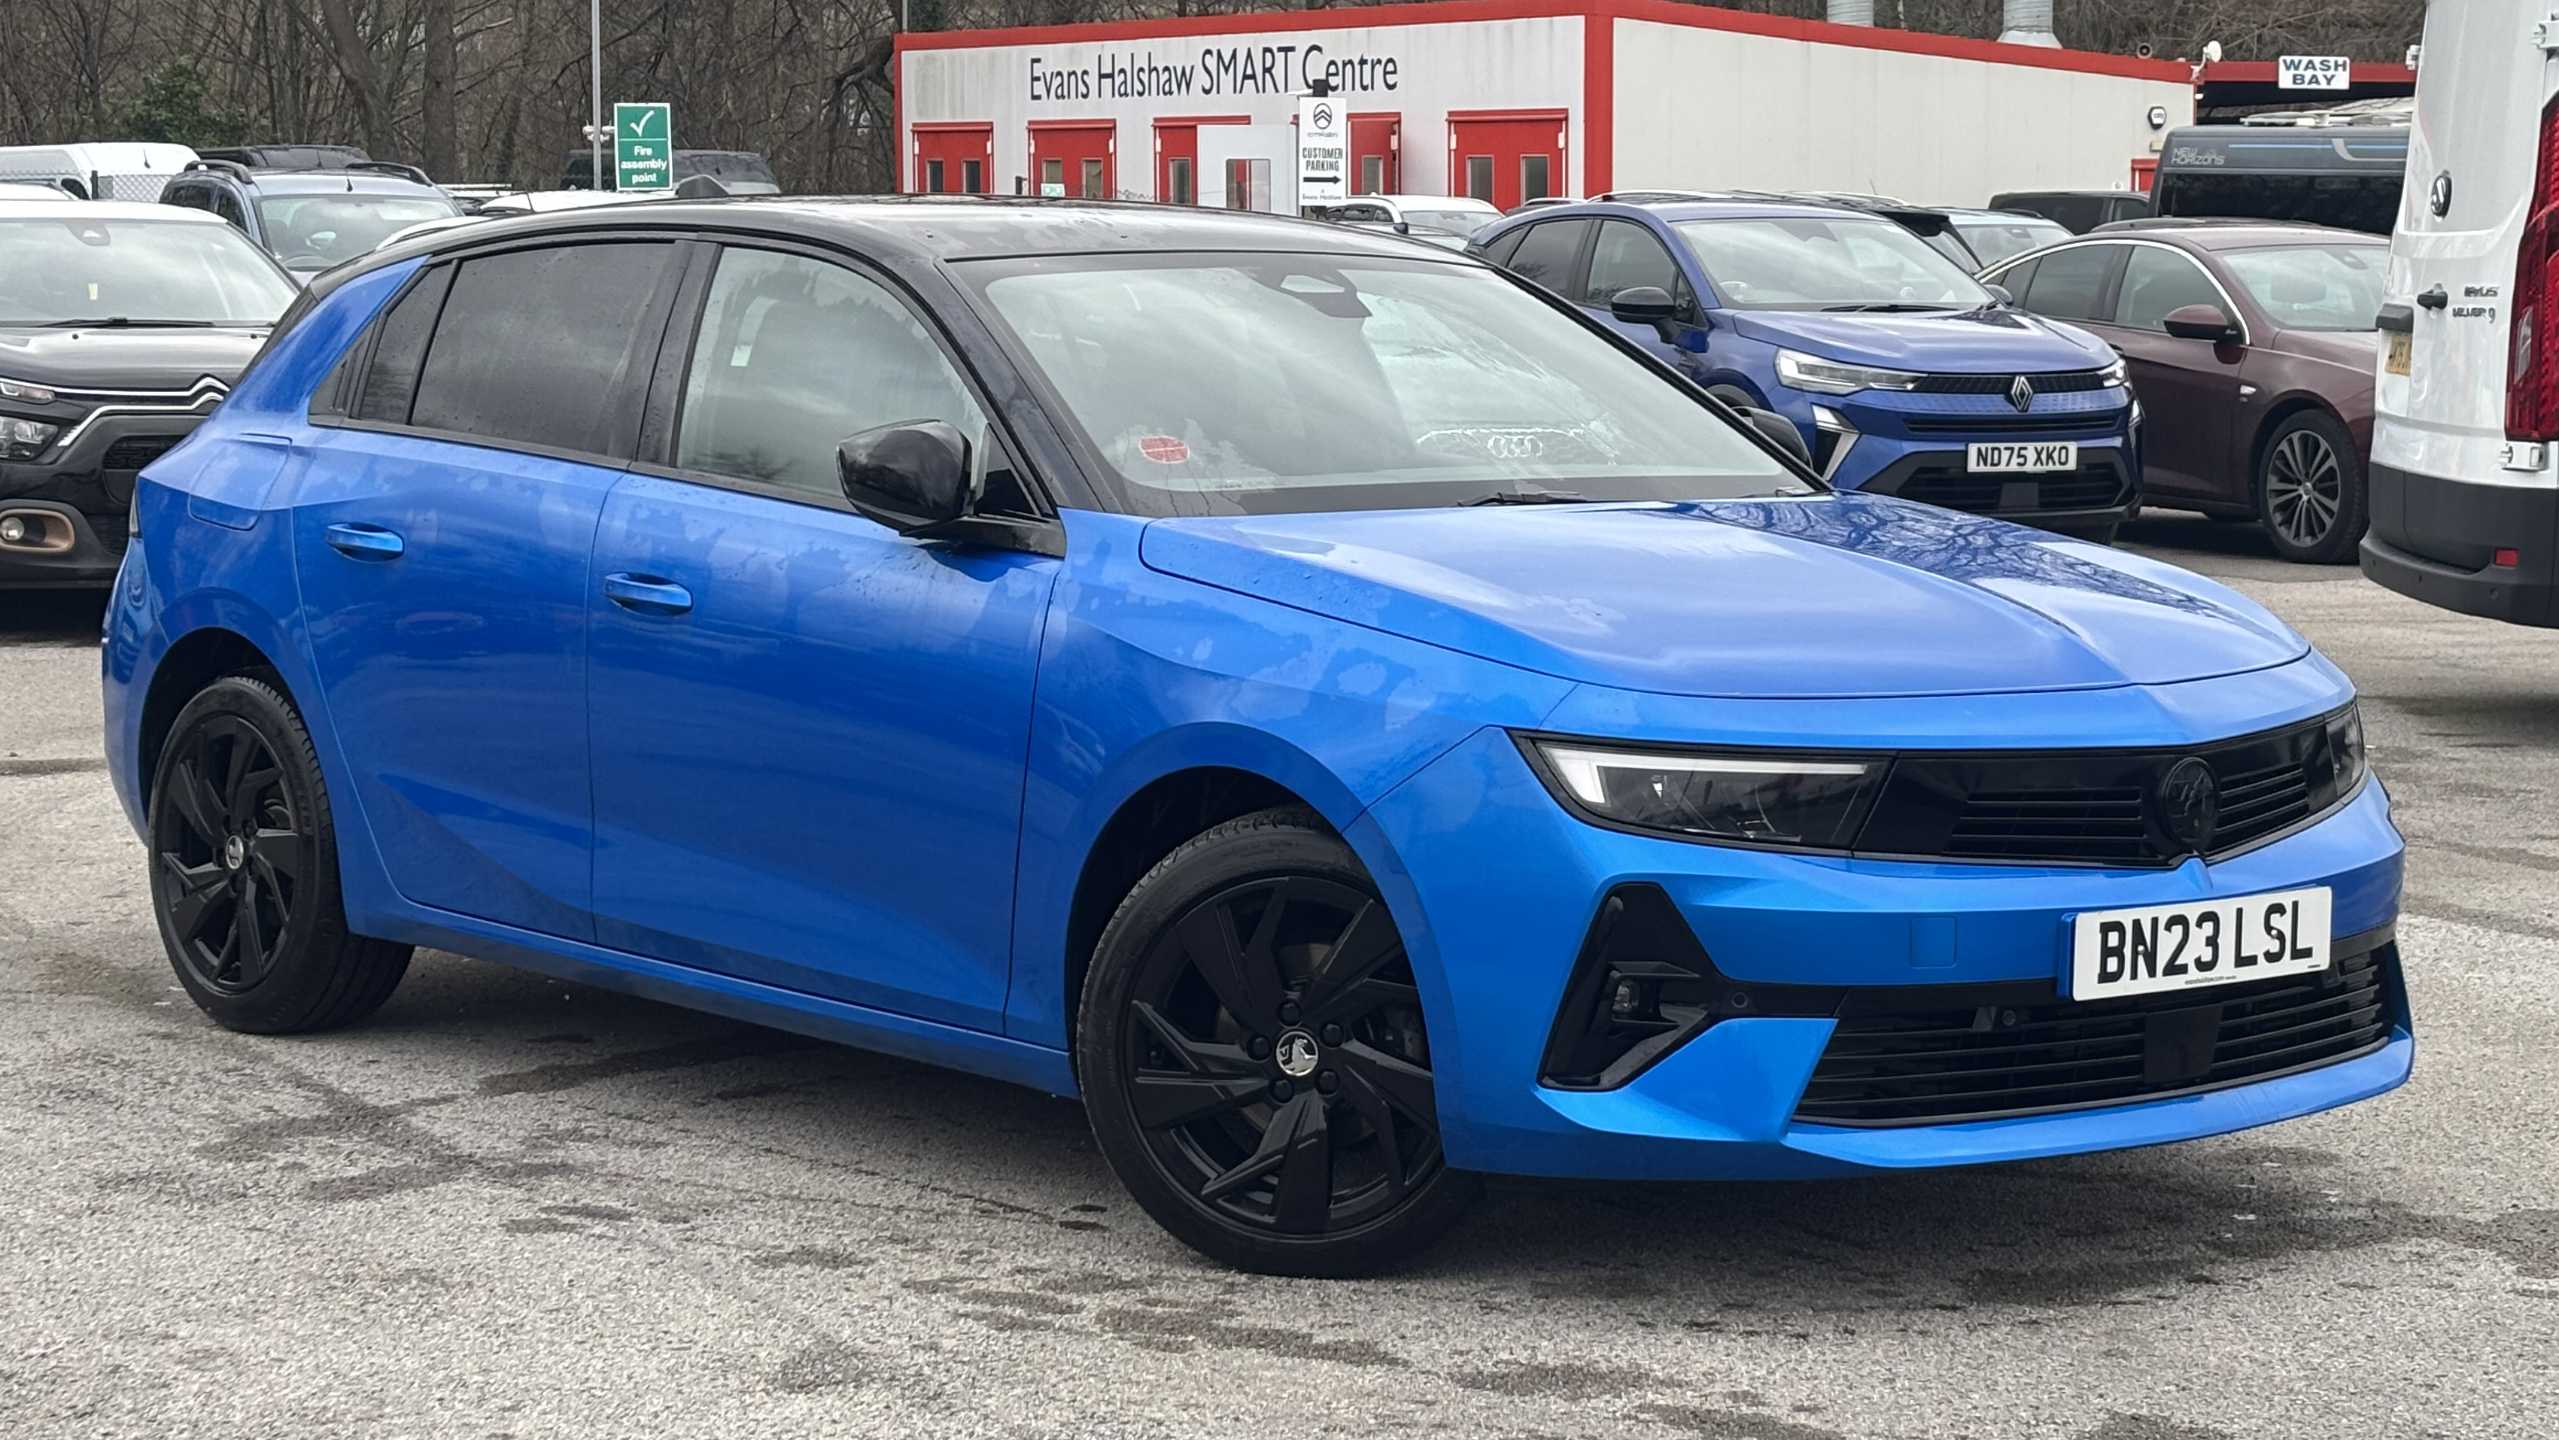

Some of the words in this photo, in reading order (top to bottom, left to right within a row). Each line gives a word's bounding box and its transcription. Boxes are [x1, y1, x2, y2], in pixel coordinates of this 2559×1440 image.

[2282, 58, 2348, 72] WASH
[1030, 57, 1090, 101] Evans
[1098, 51, 1195, 99] Halshaw
[1201, 45, 1296, 96] SMART
[1302, 44, 1398, 92] Centre
[2292, 73, 2336, 86] BAY
[633, 145, 653, 156] Fire
[1302, 147, 1343, 159] CUSTOMER
[621, 158, 667, 171] assembly
[1305, 159, 1340, 172] PARKING
[632, 172, 657, 185] point
[1976, 446, 2028, 468] ND75
[2033, 445, 2069, 467] XKO
[2097, 911, 2221, 985] BN23
[2234, 900, 2314, 969] LSL
